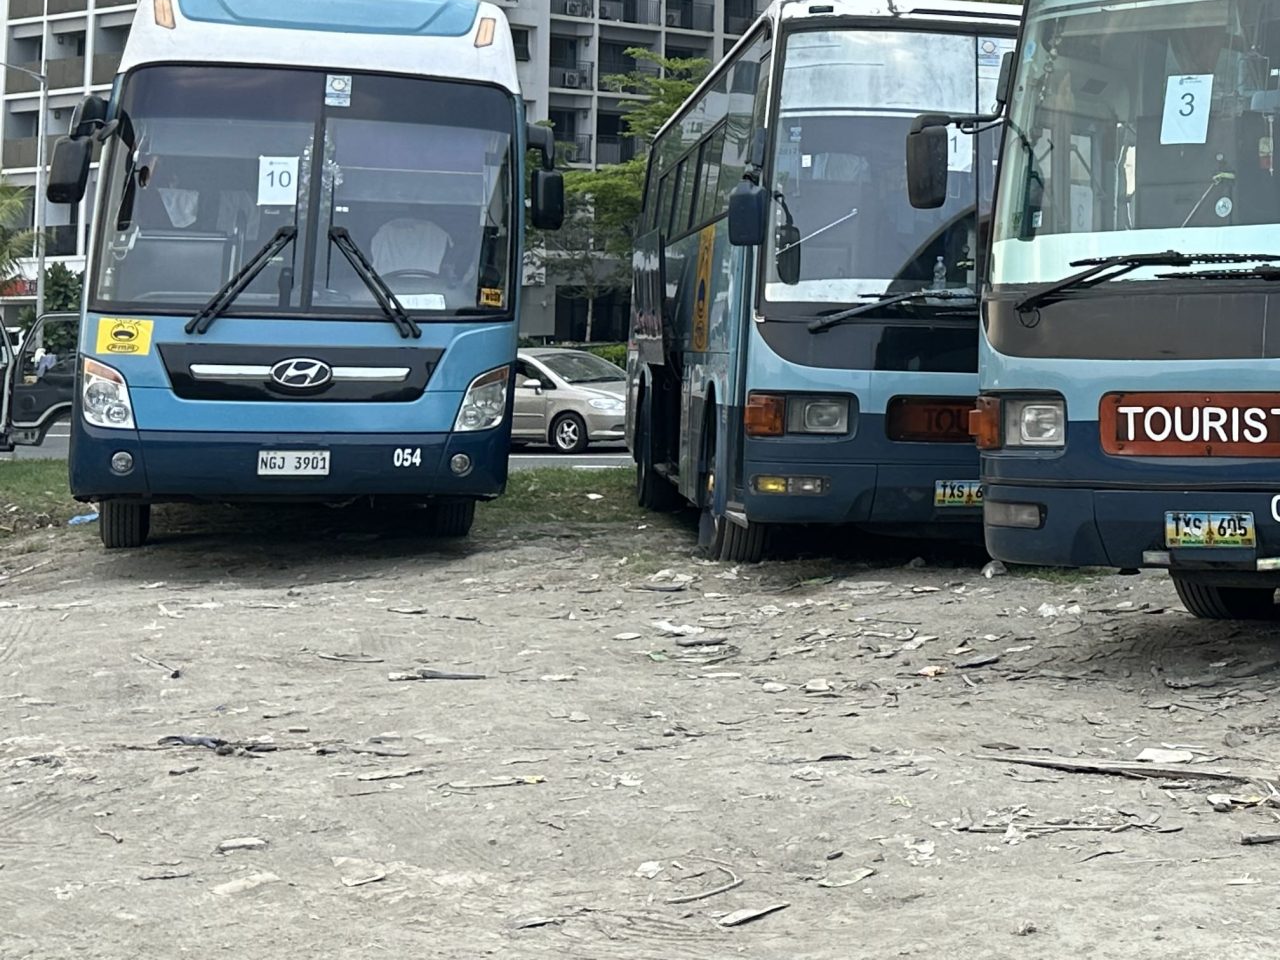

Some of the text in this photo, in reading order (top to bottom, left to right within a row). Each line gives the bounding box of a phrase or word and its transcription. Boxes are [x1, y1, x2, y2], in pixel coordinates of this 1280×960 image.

[1179, 93, 1195, 117] 3
[266, 171, 292, 188] 10
[260, 456, 327, 470] NGJ 3901
[393, 448, 422, 468] 054
[941, 484, 964, 499] TXS
